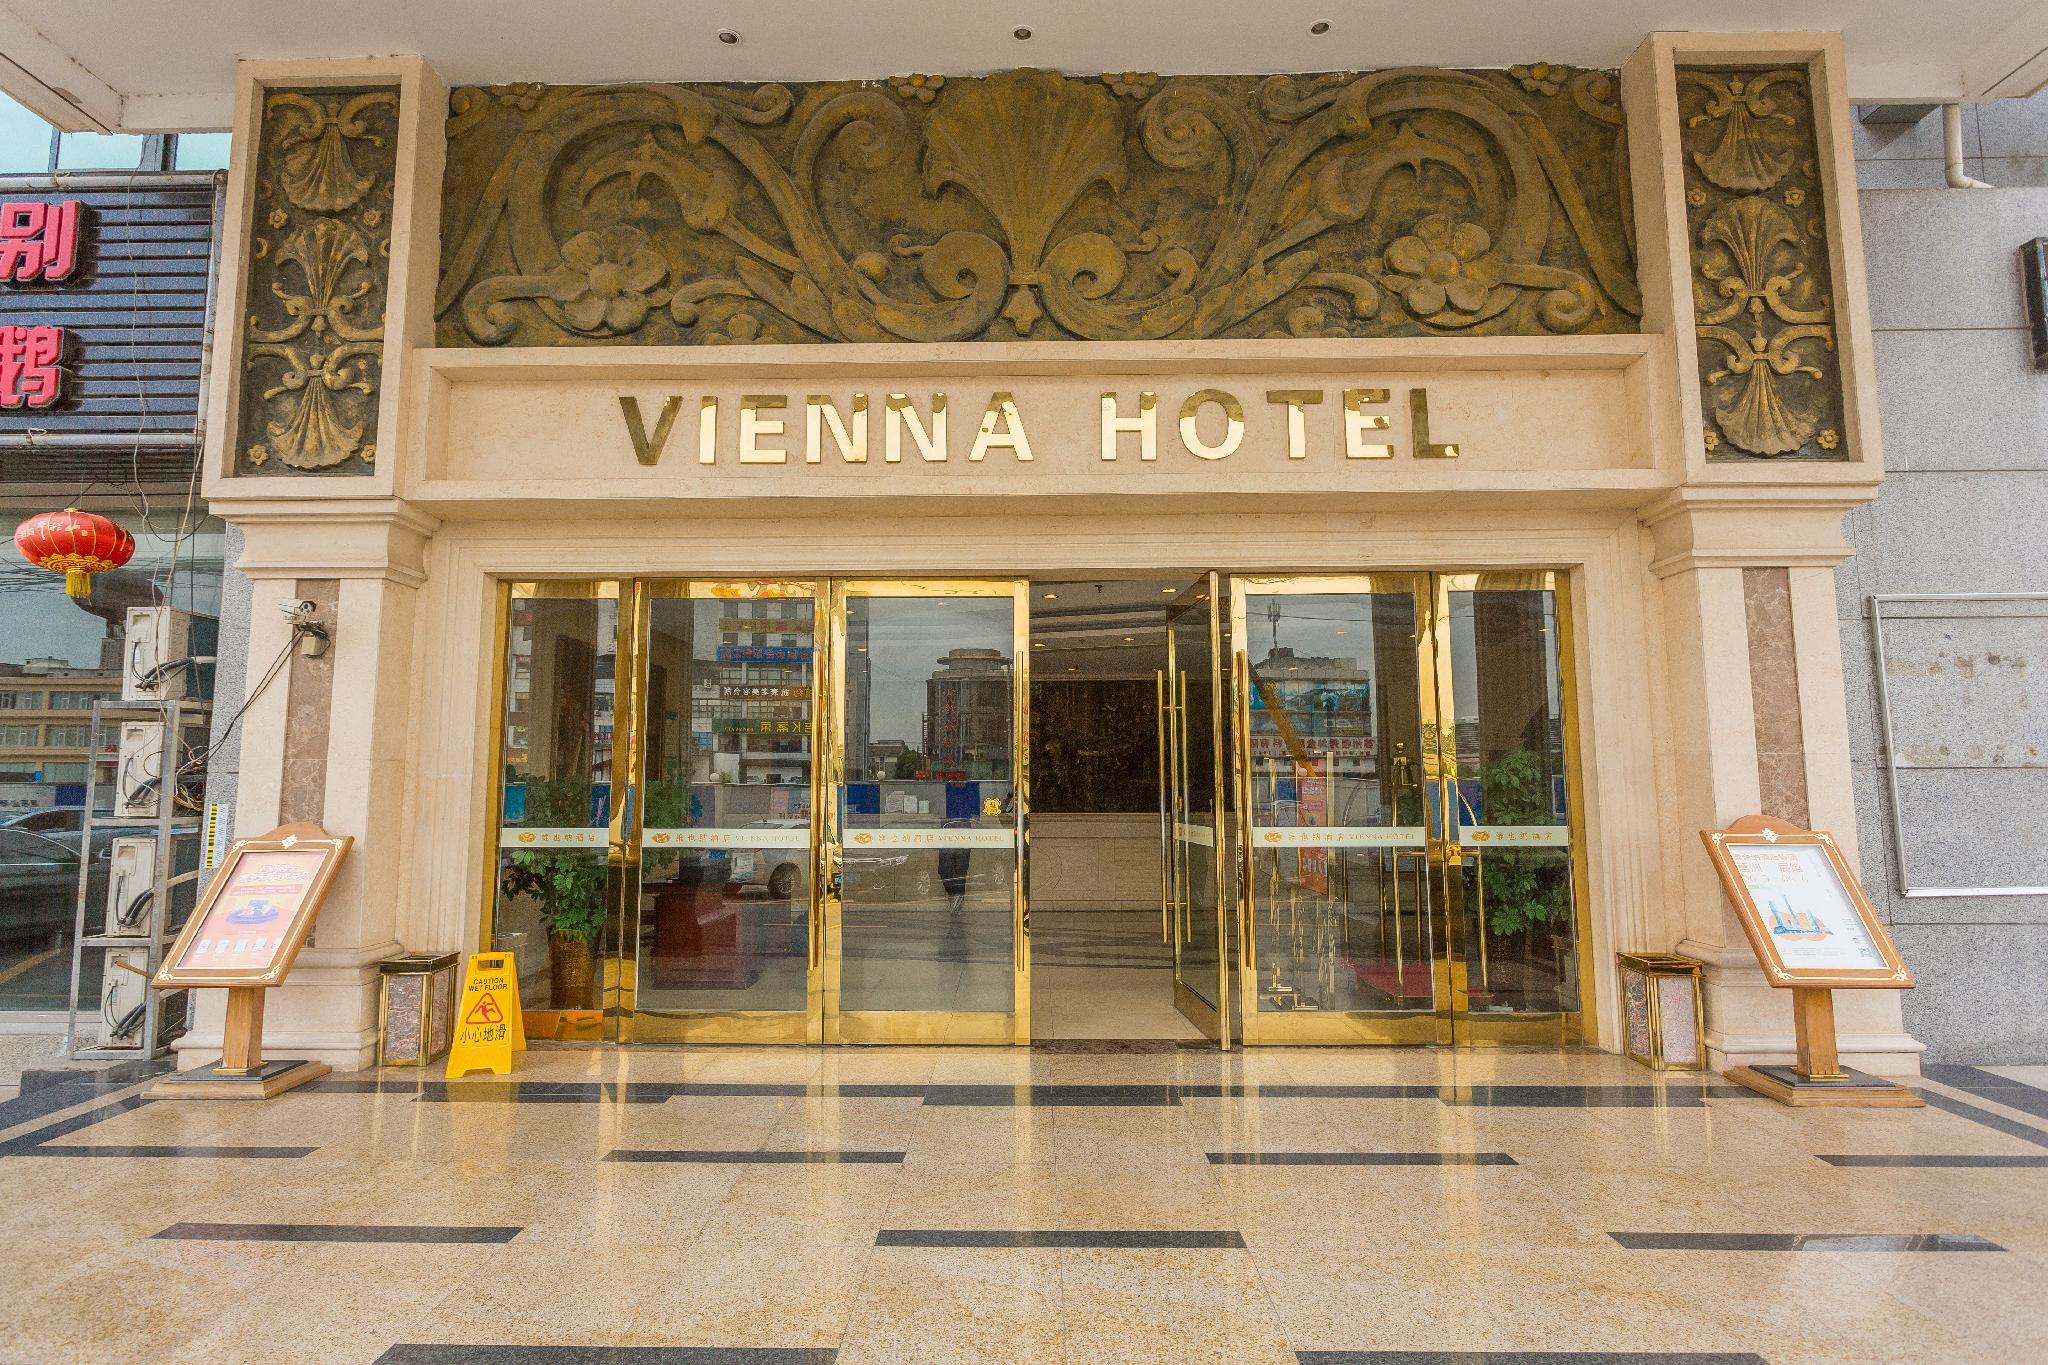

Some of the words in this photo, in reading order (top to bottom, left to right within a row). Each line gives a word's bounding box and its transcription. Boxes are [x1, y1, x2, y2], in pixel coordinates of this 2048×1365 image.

[618, 390, 1035, 466] VIENNA
[1099, 387, 1460, 462] HOTEL
[473, 977, 504, 985] CAUTION
[484, 983, 508, 991] FLOOR
[459, 1024, 507, 1043] 小心地滑
